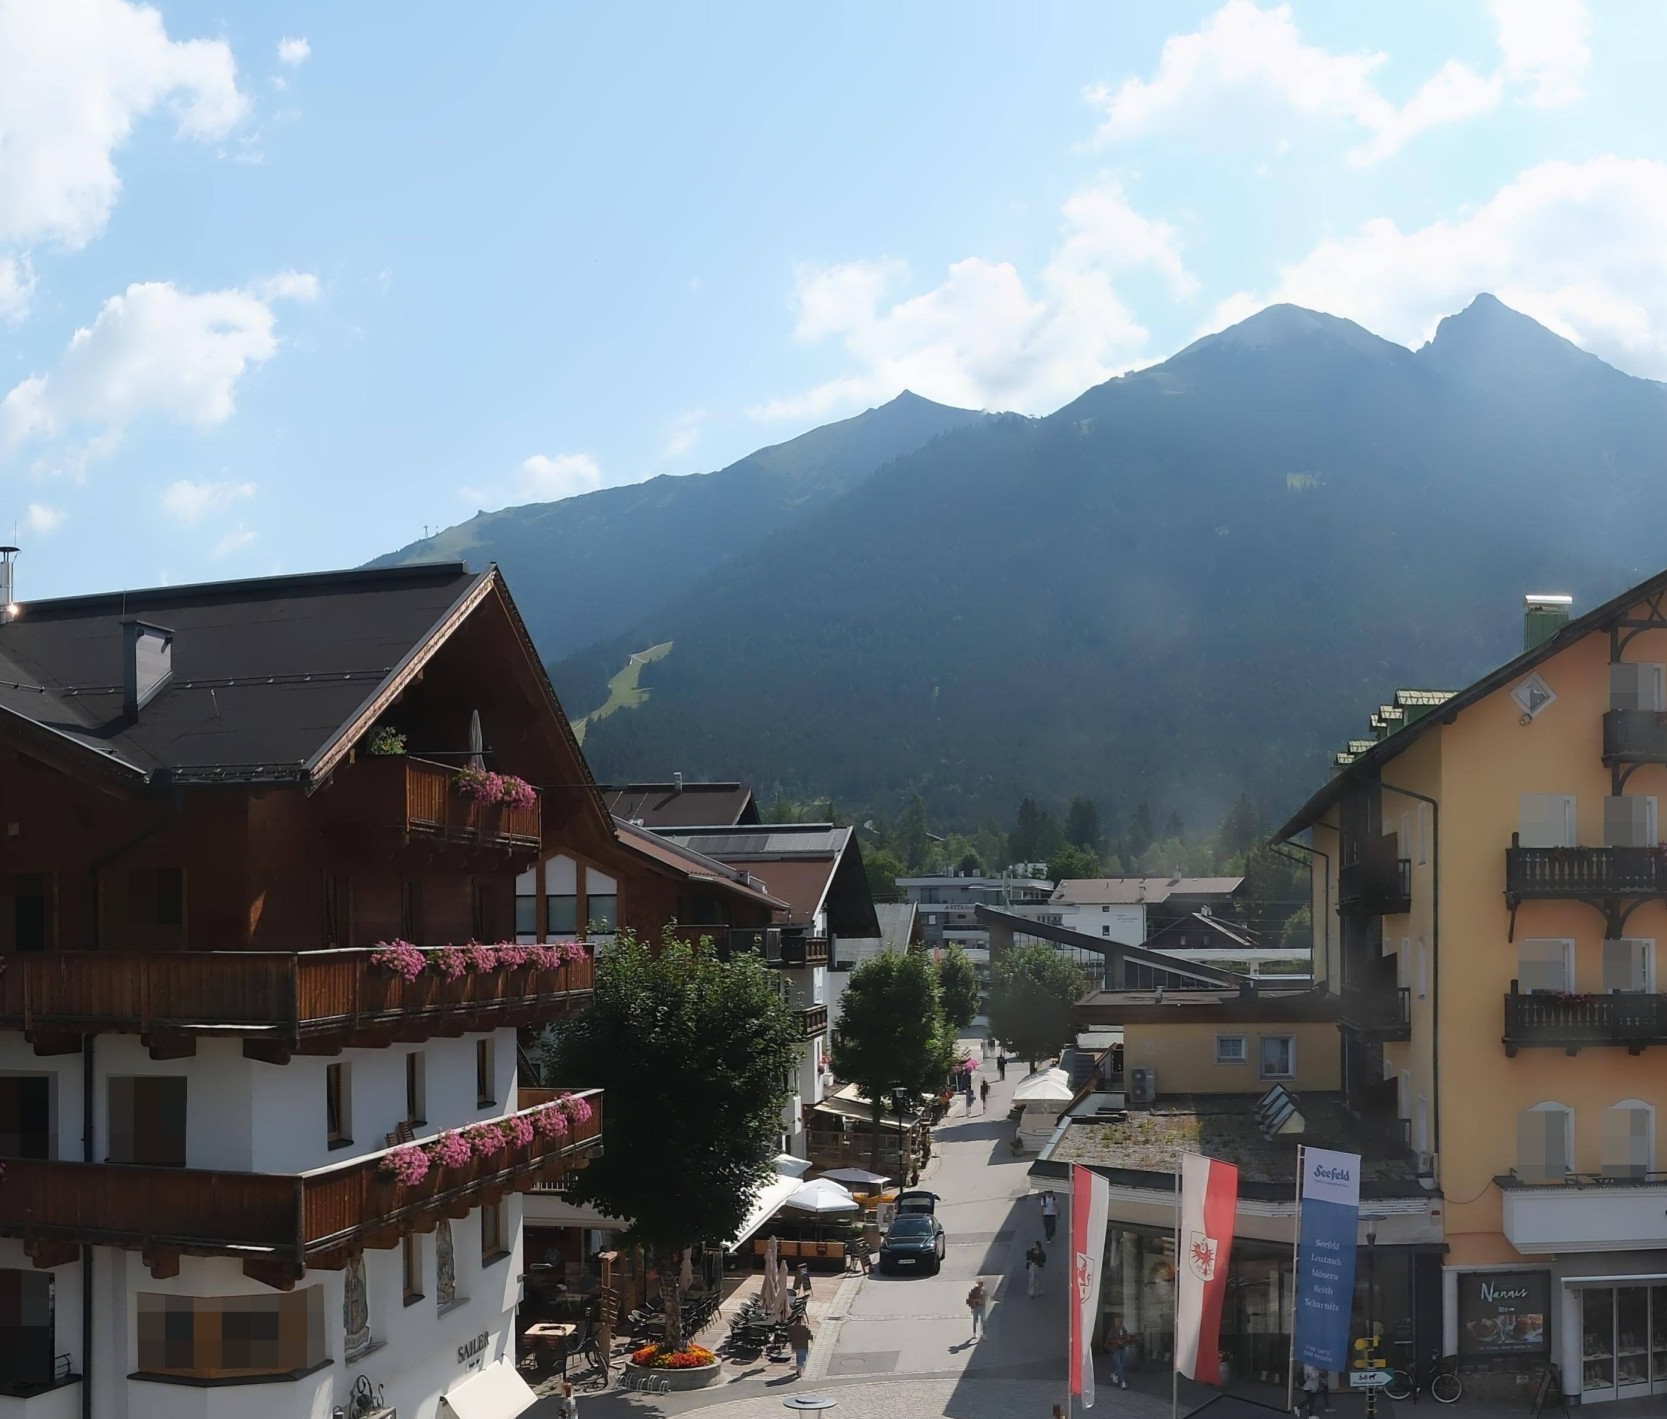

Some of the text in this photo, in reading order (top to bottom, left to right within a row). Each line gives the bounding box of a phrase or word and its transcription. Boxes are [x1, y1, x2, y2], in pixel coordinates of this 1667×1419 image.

[1314, 1164, 1350, 1182] Seefeld
[1315, 1239, 1340, 1251] Seefeld
[1312, 1268, 1339, 1282] Mösern
[1313, 1284, 1334, 1296] Reith
[1305, 1298, 1340, 1312] Scharnitz
[457, 1331, 490, 1363] SAILER
